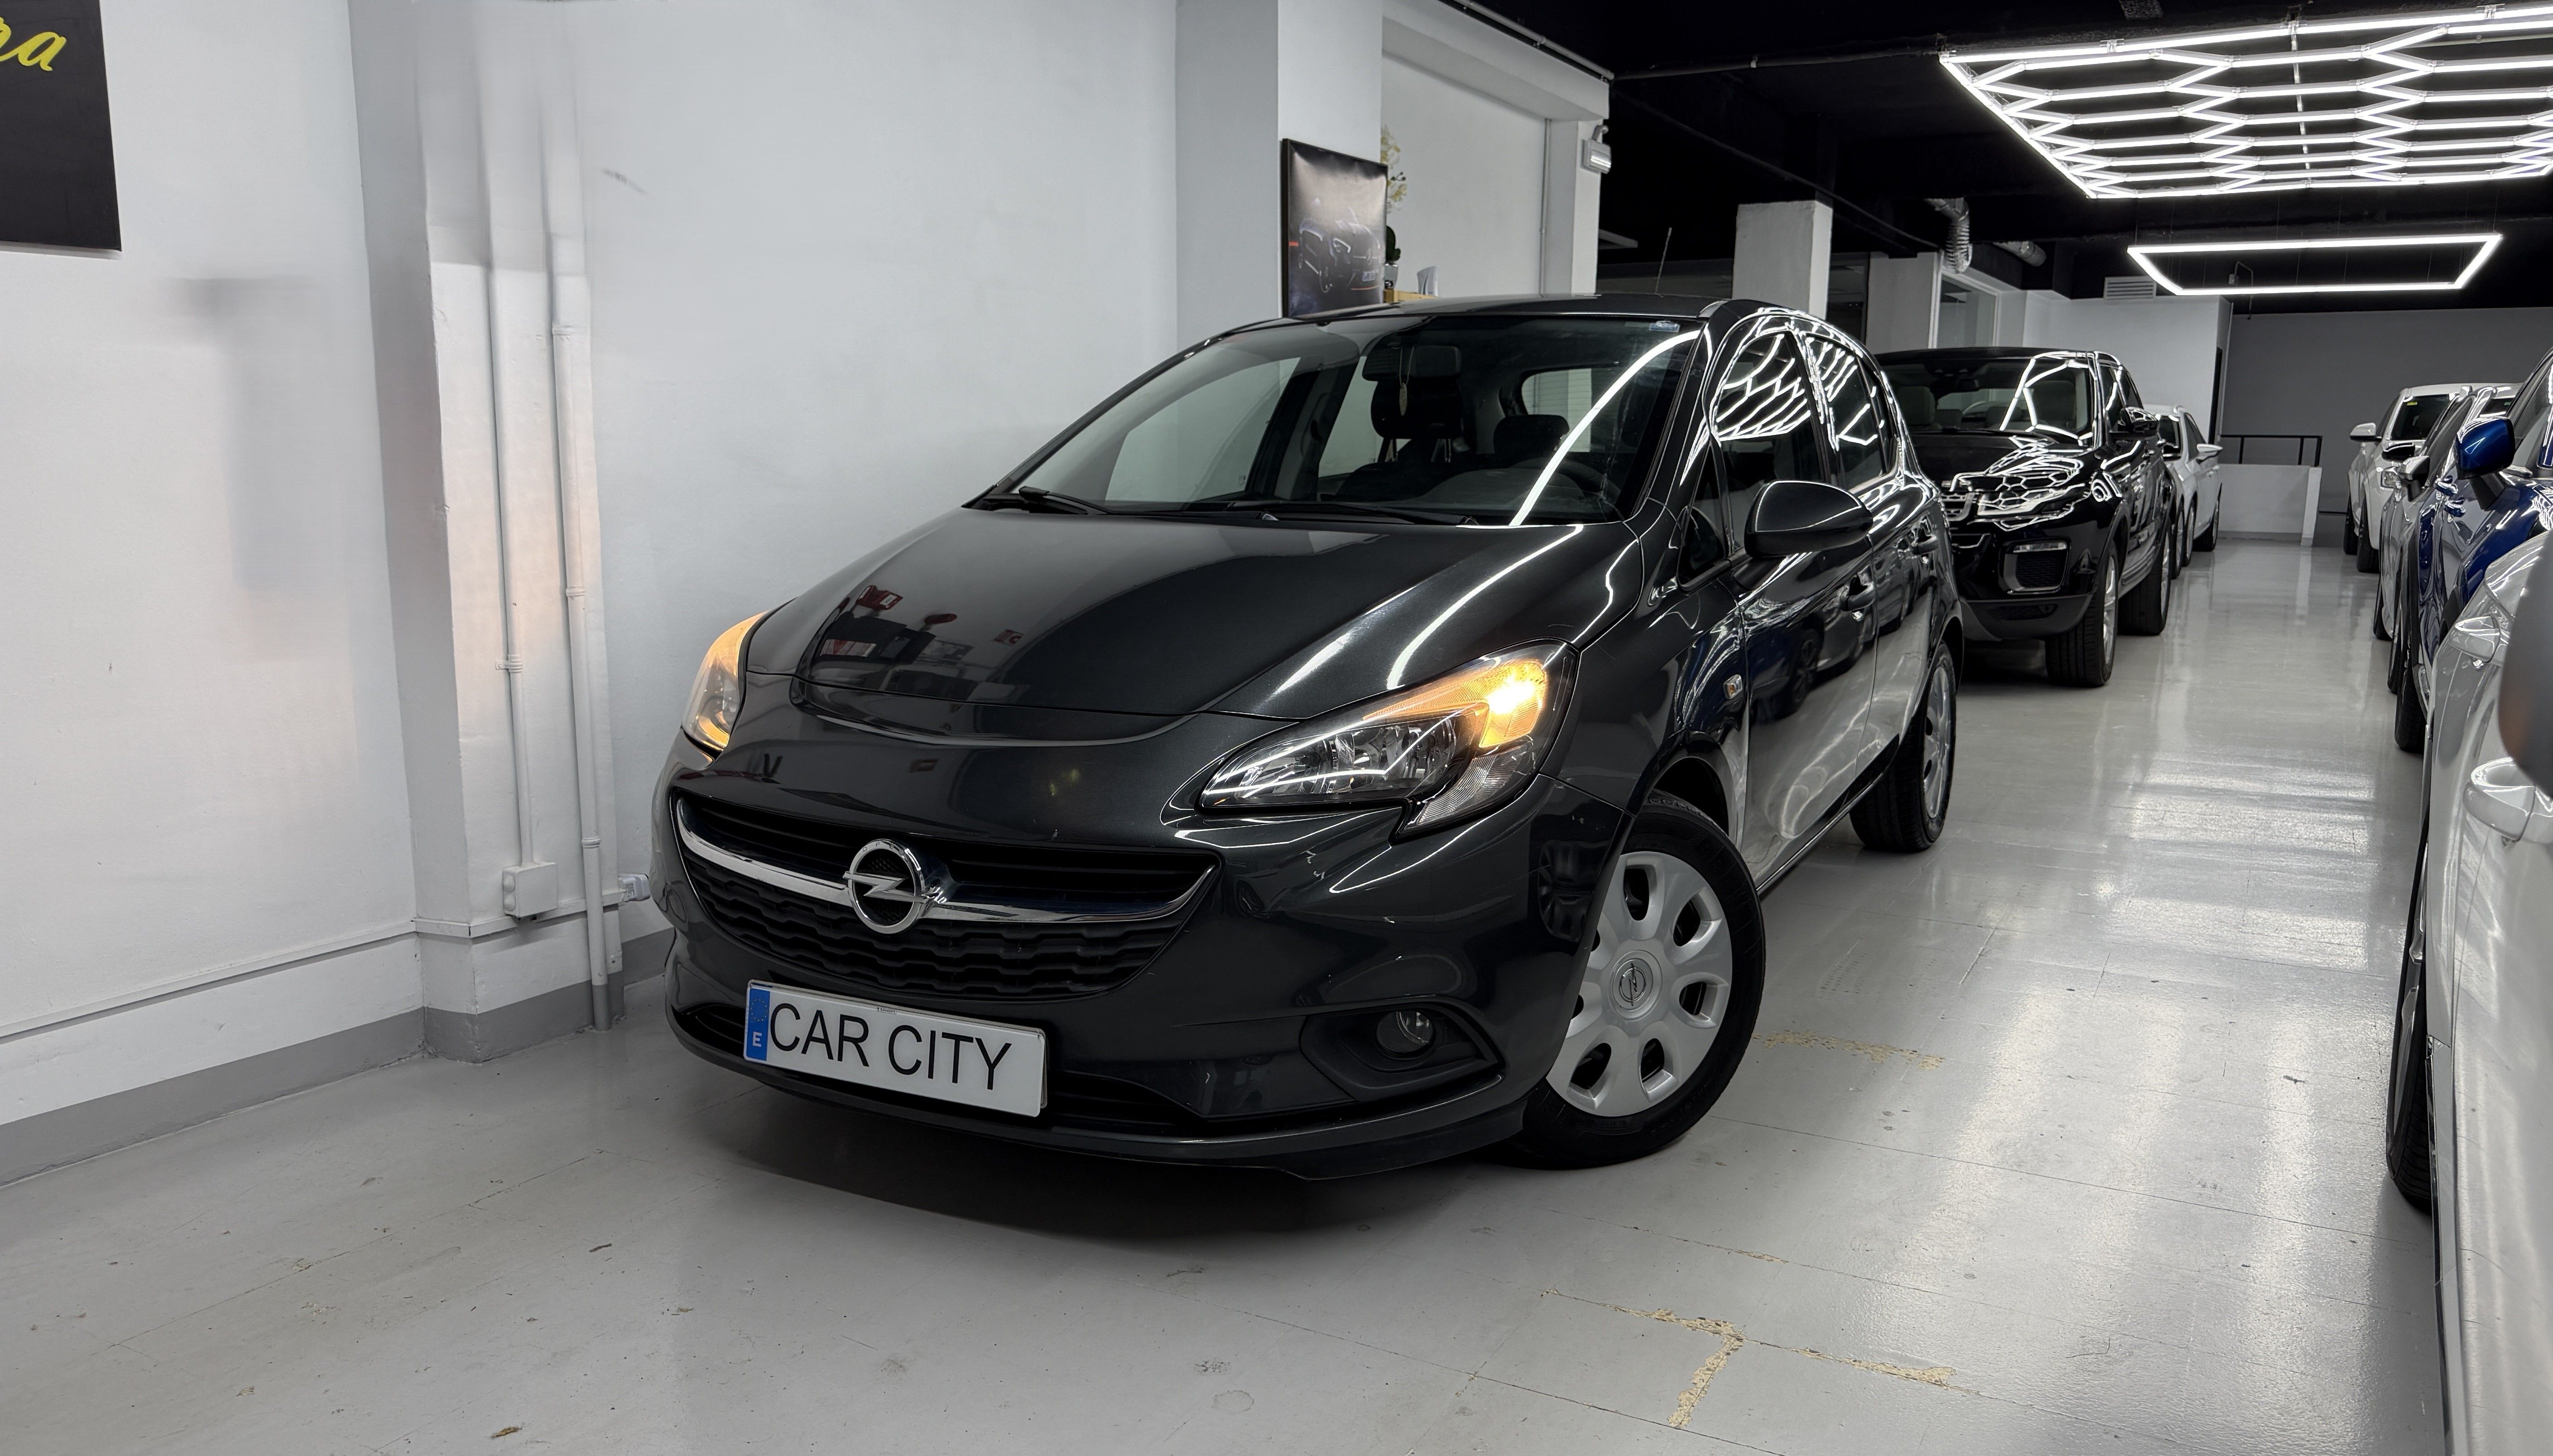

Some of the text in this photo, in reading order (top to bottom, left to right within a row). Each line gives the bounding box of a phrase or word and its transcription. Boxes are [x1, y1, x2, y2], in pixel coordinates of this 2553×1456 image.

[752, 1031, 762, 1047] E
[770, 1003, 1012, 1090] CAR CITY
